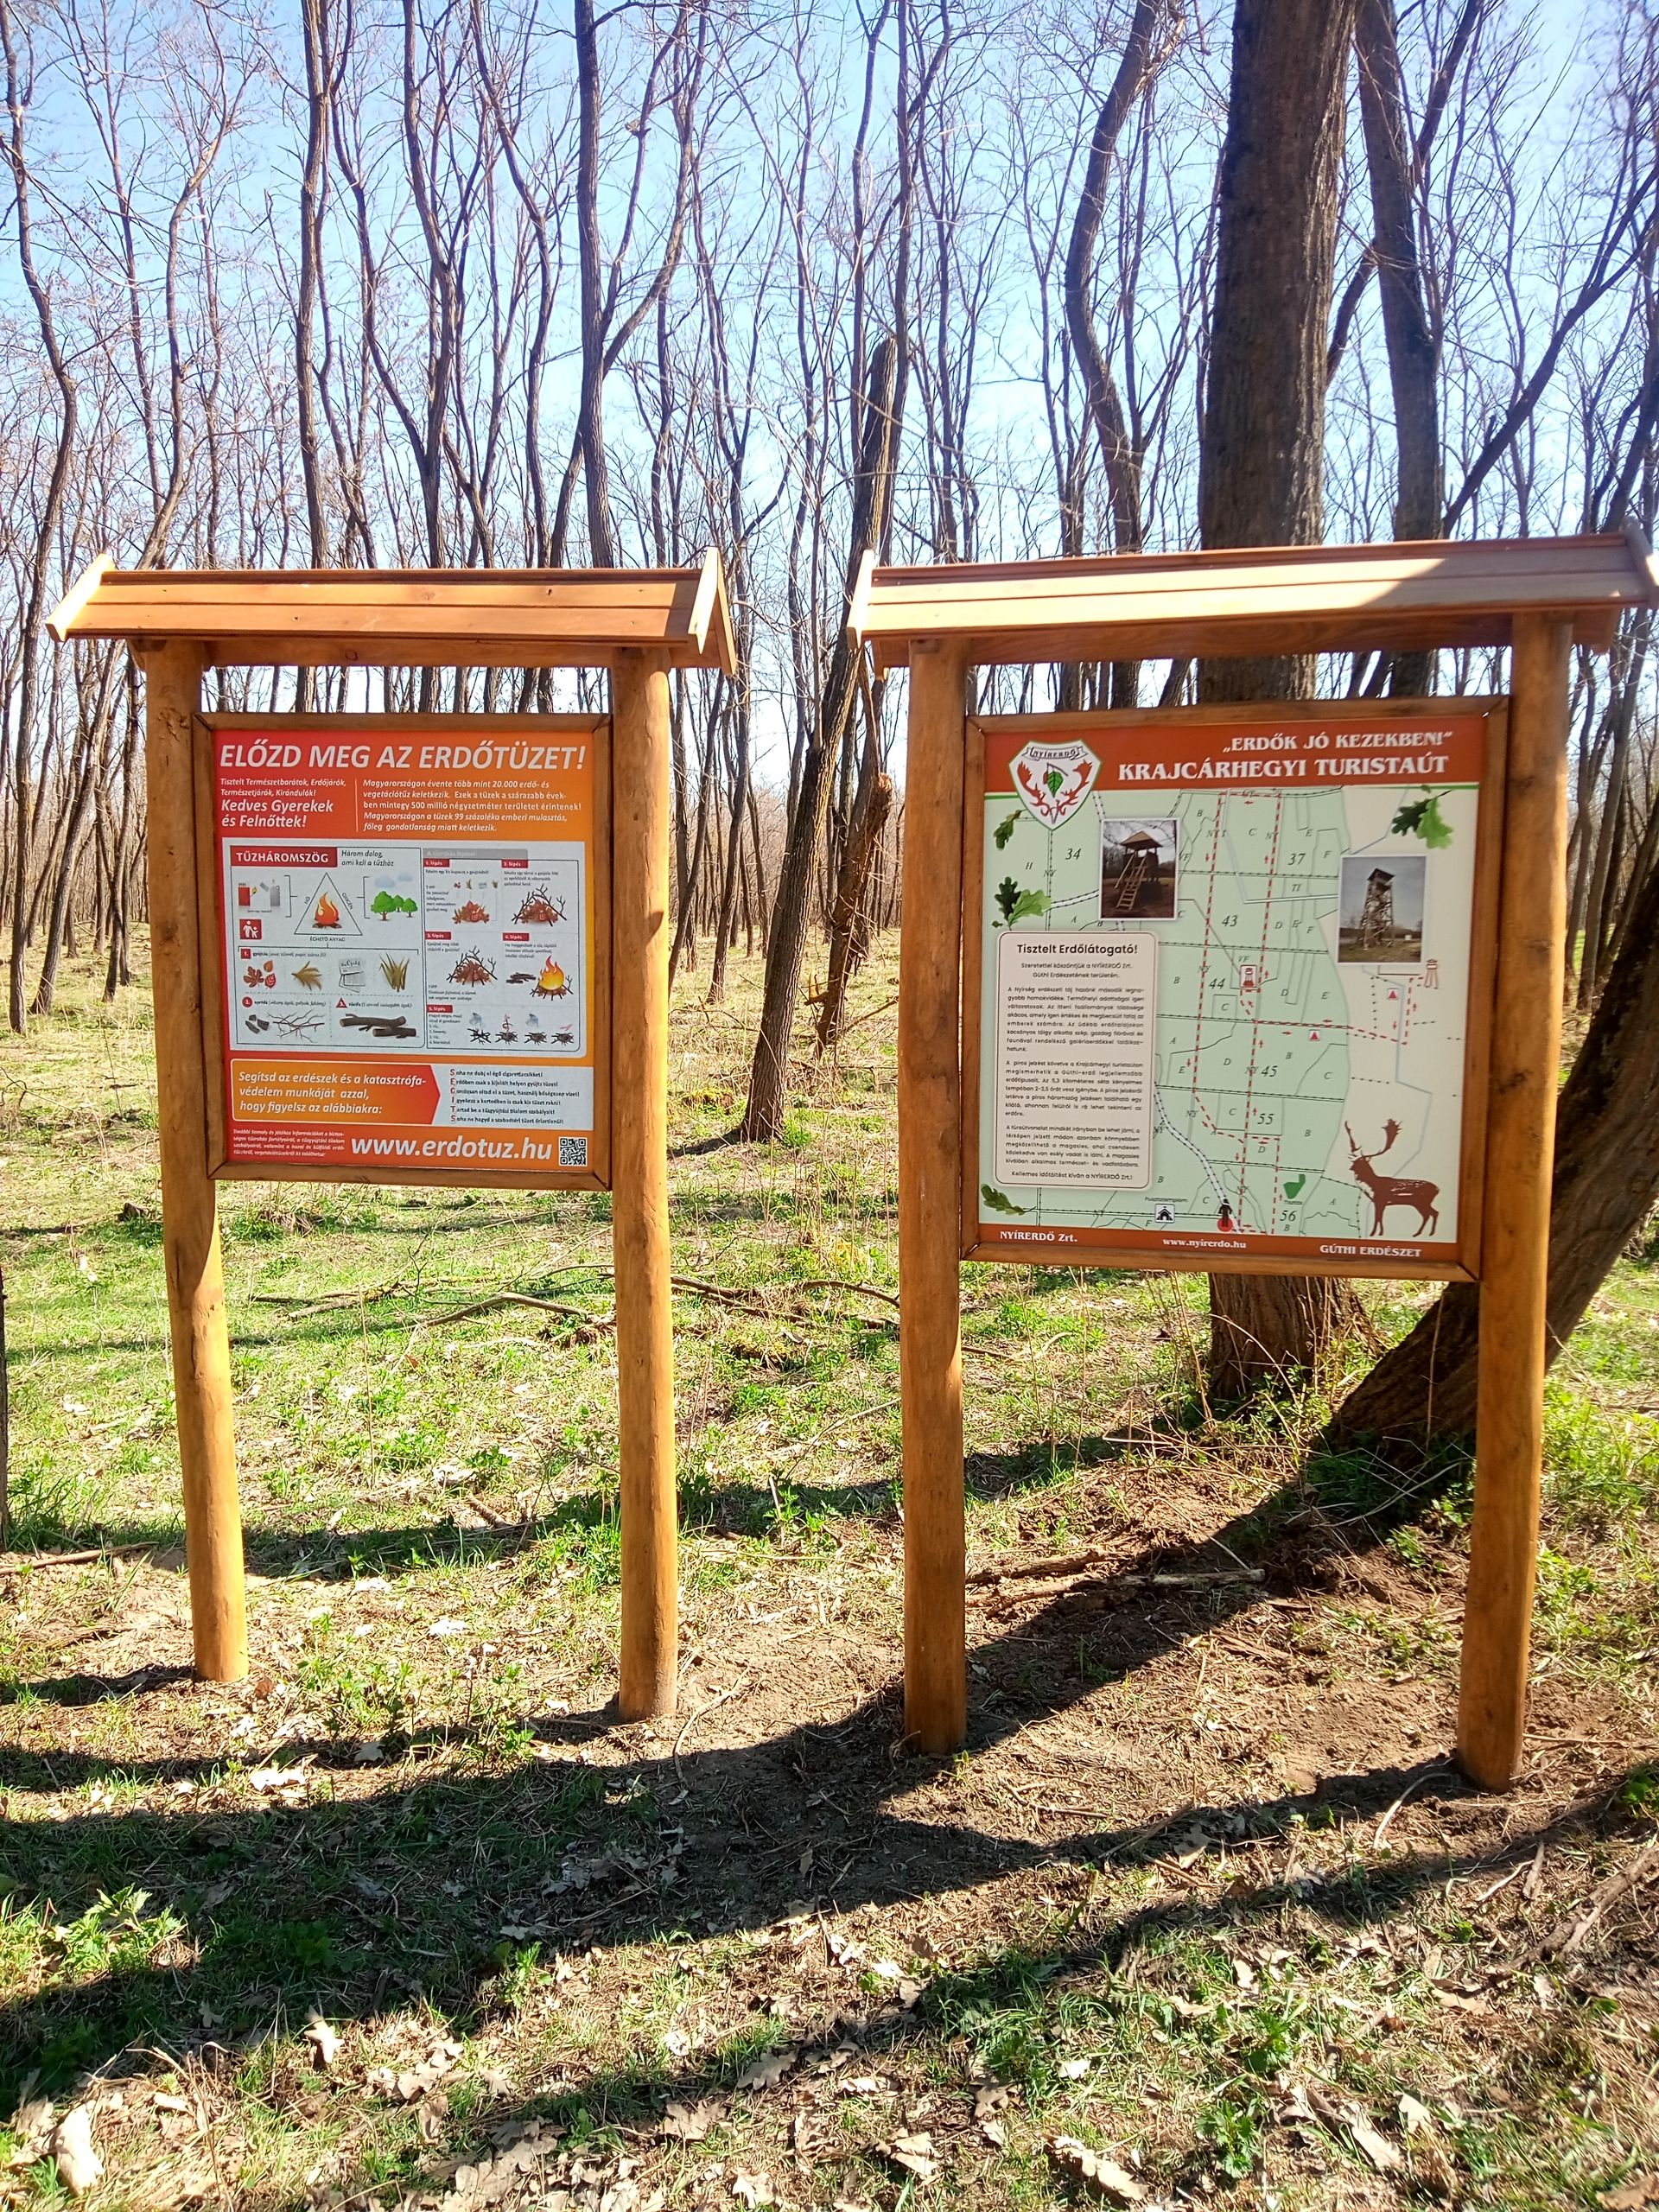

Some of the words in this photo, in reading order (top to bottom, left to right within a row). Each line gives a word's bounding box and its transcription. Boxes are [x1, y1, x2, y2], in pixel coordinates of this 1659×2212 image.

[1302, 733, 1329, 750] JÓ
[220, 739, 301, 767] ELŐZD
[308, 745, 370, 767] MEG
[377, 745, 413, 768] AZ
[418, 740, 586, 769] ERDŐTÜZET!
[1117, 758, 1305, 780] KRAJCÁRHEGYI
[1312, 752, 1447, 776] TURISTAÚT
[245, 778, 309, 786] Természetbarátok,
[310, 779, 346, 787] Erdőjárók,
[363, 779, 426, 788] Magyarországon
[220, 788, 274, 798] Természetjárók,
[363, 790, 410, 799] vegetációtűz
[221, 798, 268, 811] Kedves
[271, 799, 334, 814] Gyerekek
[379, 802, 410, 810] mintegy
[505, 802, 539, 810] területet
[222, 814, 236, 827] és
[239, 814, 307, 828] Felnőttek!
[364, 812, 425, 821] Magyarországon
[454, 812, 464, 821] 99
[363, 823, 383, 831] főleg
[385, 823, 436, 832] gondatlanság
[1249, 828, 1257, 836] C
[236, 851, 328, 863] TŰZHÁROMSZÖG
[365, 850, 384, 859] dolog,
[1065, 849, 1082, 860] 34
[1287, 853, 1306, 866] 37
[1222, 916, 1238, 927] 43
[1274, 921, 1282, 930] D
[1017, 944, 1057, 954] Tisztelt
[1059, 944, 1137, 957] Erdőlátogató!
[1208, 978, 1225, 988] 44
[1224, 1058, 1231, 1066] D
[1261, 1066, 1278, 1077] 45
[238, 1071, 276, 1084] Segítsd
[292, 1072, 338, 1084] erdészek
[340, 1073, 352, 1084] és
[363, 1074, 426, 1087] katasztrófa-
[239, 1085, 283, 1096] védelem
[285, 1087, 335, 1099] munkáját
[340, 1089, 369, 1100] azzal,
[240, 1101, 266, 1113] hogy
[267, 1101, 306, 1114] figyelsz
[322, 1103, 382, 1114] alábbiakra:
[1256, 1114, 1274, 1125] 55
[351, 1135, 553, 1160] www.erdotuz.hu
[1203, 1196, 1210, 1205] C
[1280, 1211, 1296, 1222] 56
[1000, 1230, 1055, 1242] NYÍRERDŐ
[1058, 1234, 1077, 1243] Zrt.
[1162, 1238, 1246, 1249] www.nyirerdo.hu
[1319, 1244, 1356, 1255] GÚTHI
[1359, 1246, 1421, 1257] ERDÉSZET
